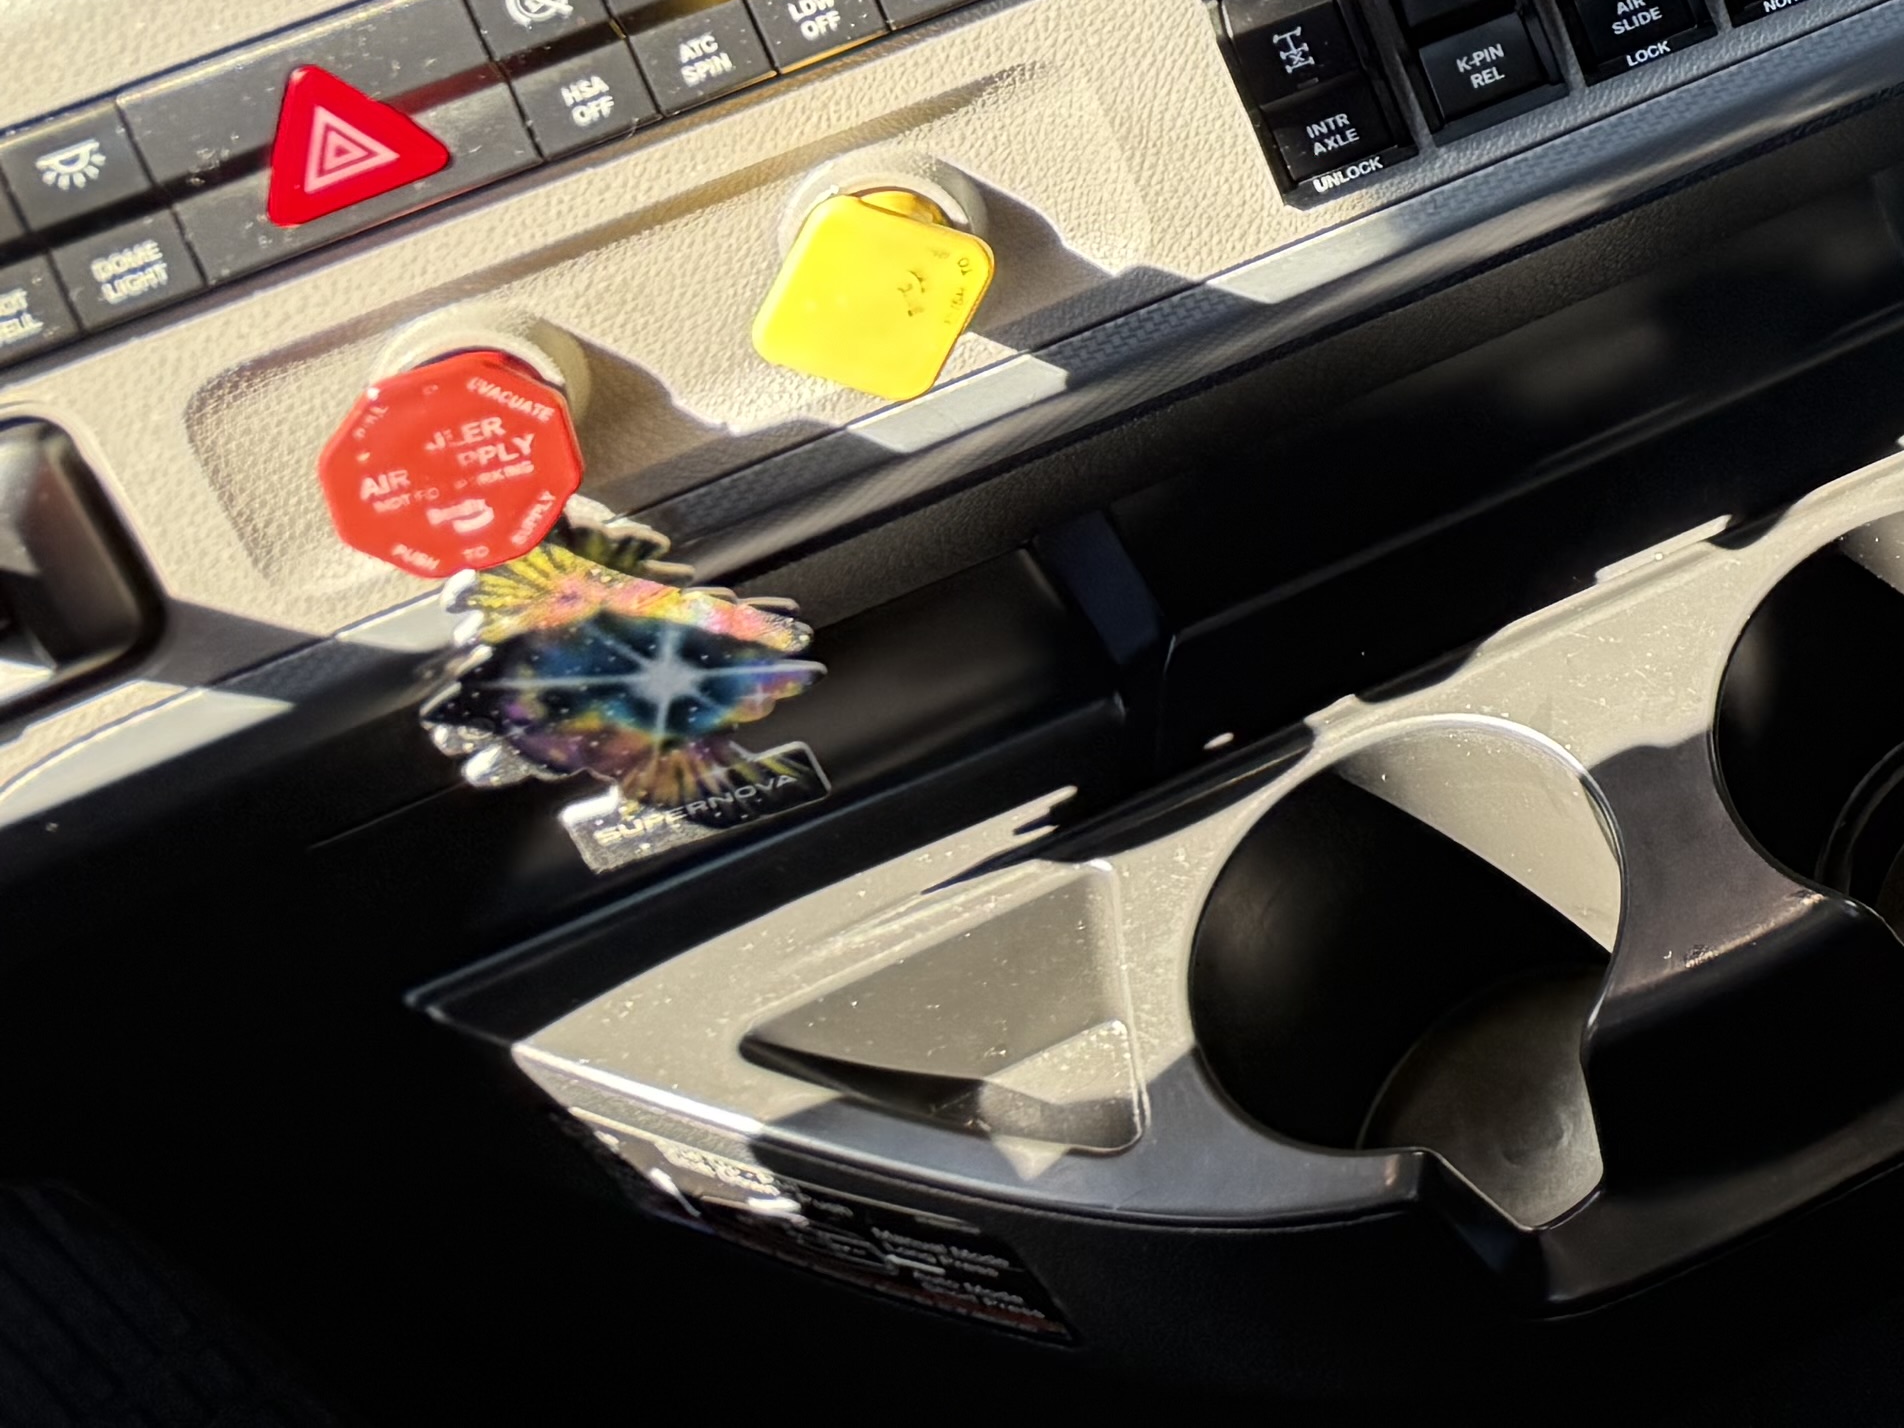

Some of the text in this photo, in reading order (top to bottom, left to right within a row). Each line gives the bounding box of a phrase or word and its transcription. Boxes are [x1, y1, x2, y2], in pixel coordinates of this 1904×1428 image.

[800, 10, 841, 41] OFF
[1611, 4, 1664, 36] SLIDE
[678, 33, 719, 63] ATC
[1455, 44, 1505, 74] K-PIN
[1625, 39, 1671, 68] LOCK
[680, 53, 732, 87] SPIN
[1468, 63, 1507, 89] REL
[561, 76, 609, 107] HSA
[572, 97, 615, 128] OFF
[1306, 112, 1351, 141] INTR
[1313, 127, 1360, 156] AXLE
[1312, 154, 1384, 194] UNLOCK
[91, 239, 163, 282] DOME
[101, 263, 168, 304] LIGHT
[466, 377, 555, 423] EVACUATE
[360, 469, 411, 500] AIR
[593, 774, 798, 845] SUPERNOVA
